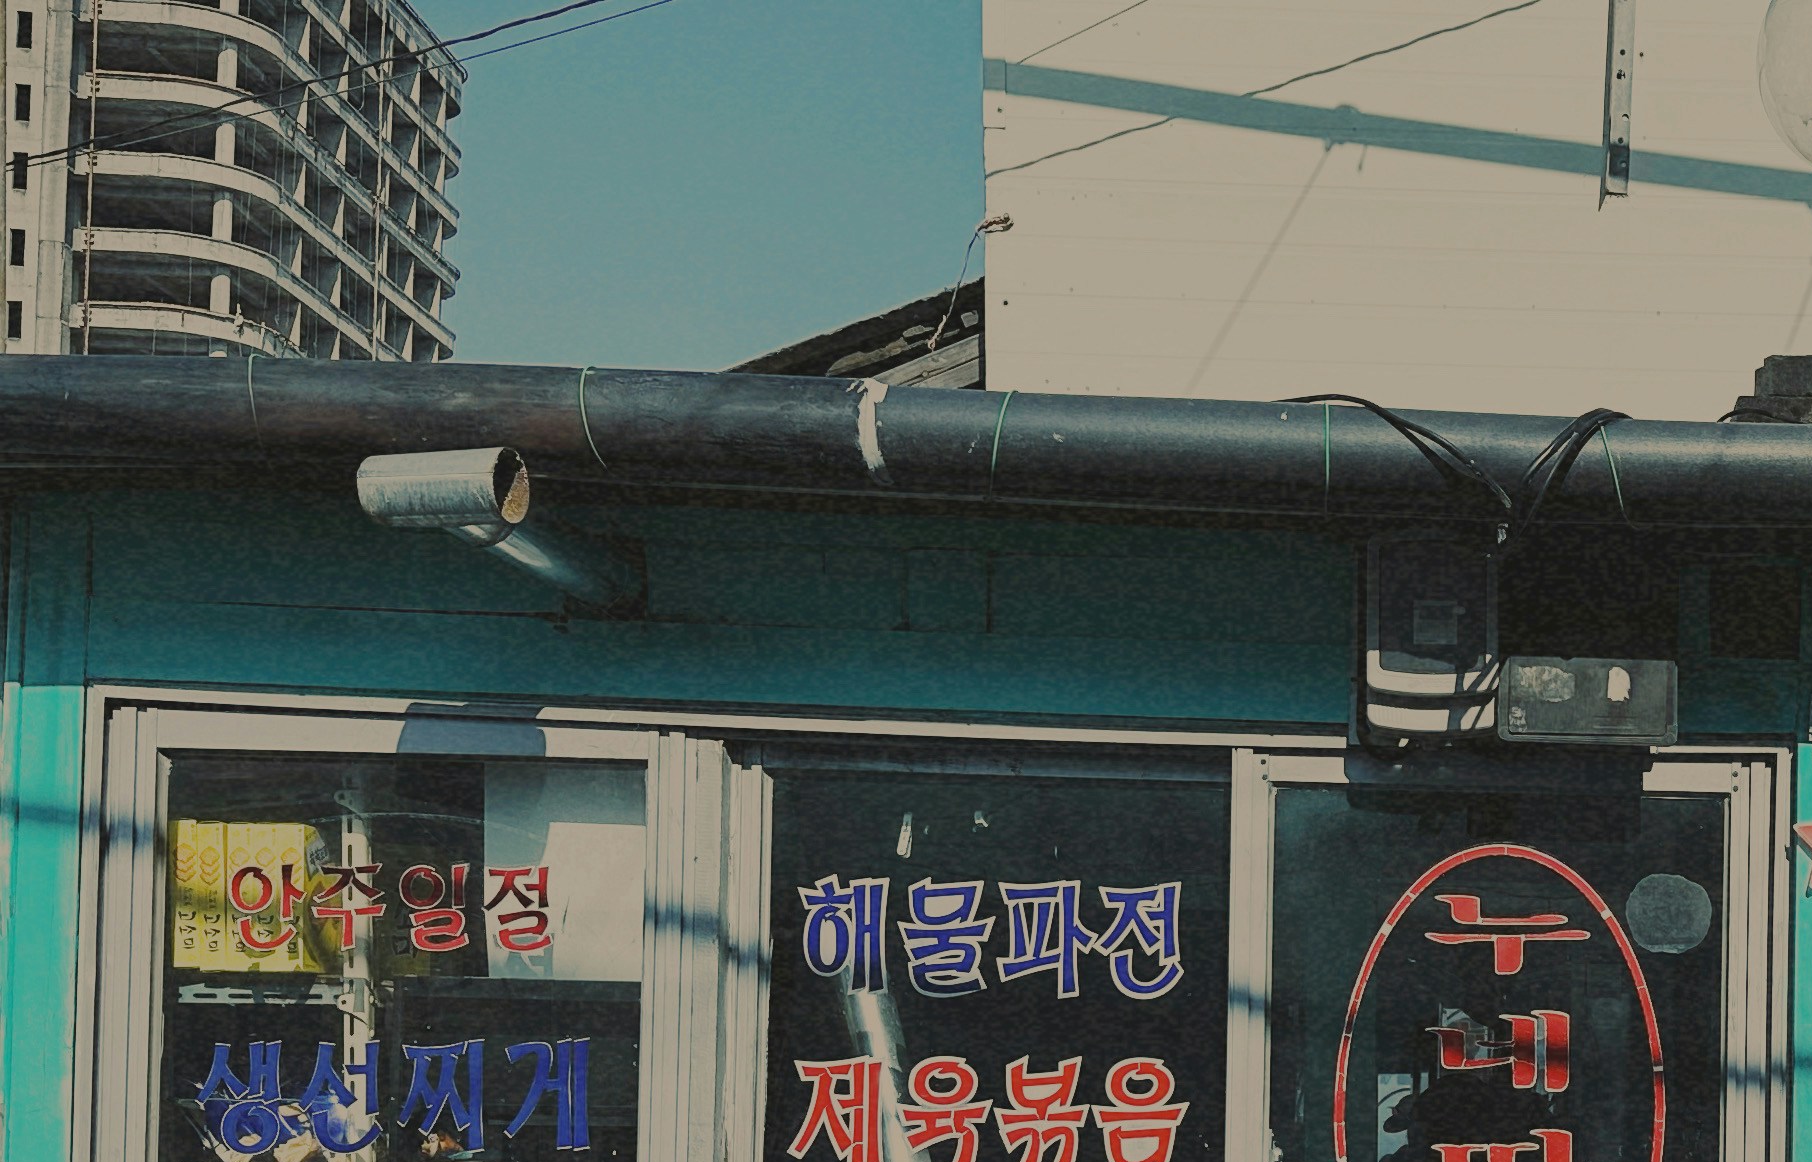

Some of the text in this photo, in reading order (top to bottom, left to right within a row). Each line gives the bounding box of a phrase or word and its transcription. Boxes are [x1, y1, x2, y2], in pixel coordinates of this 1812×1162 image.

[228, 862, 552, 952] 안주일절
[798, 874, 1184, 999] 해물파전
[196, 1037, 591, 1154] 생선찌게
